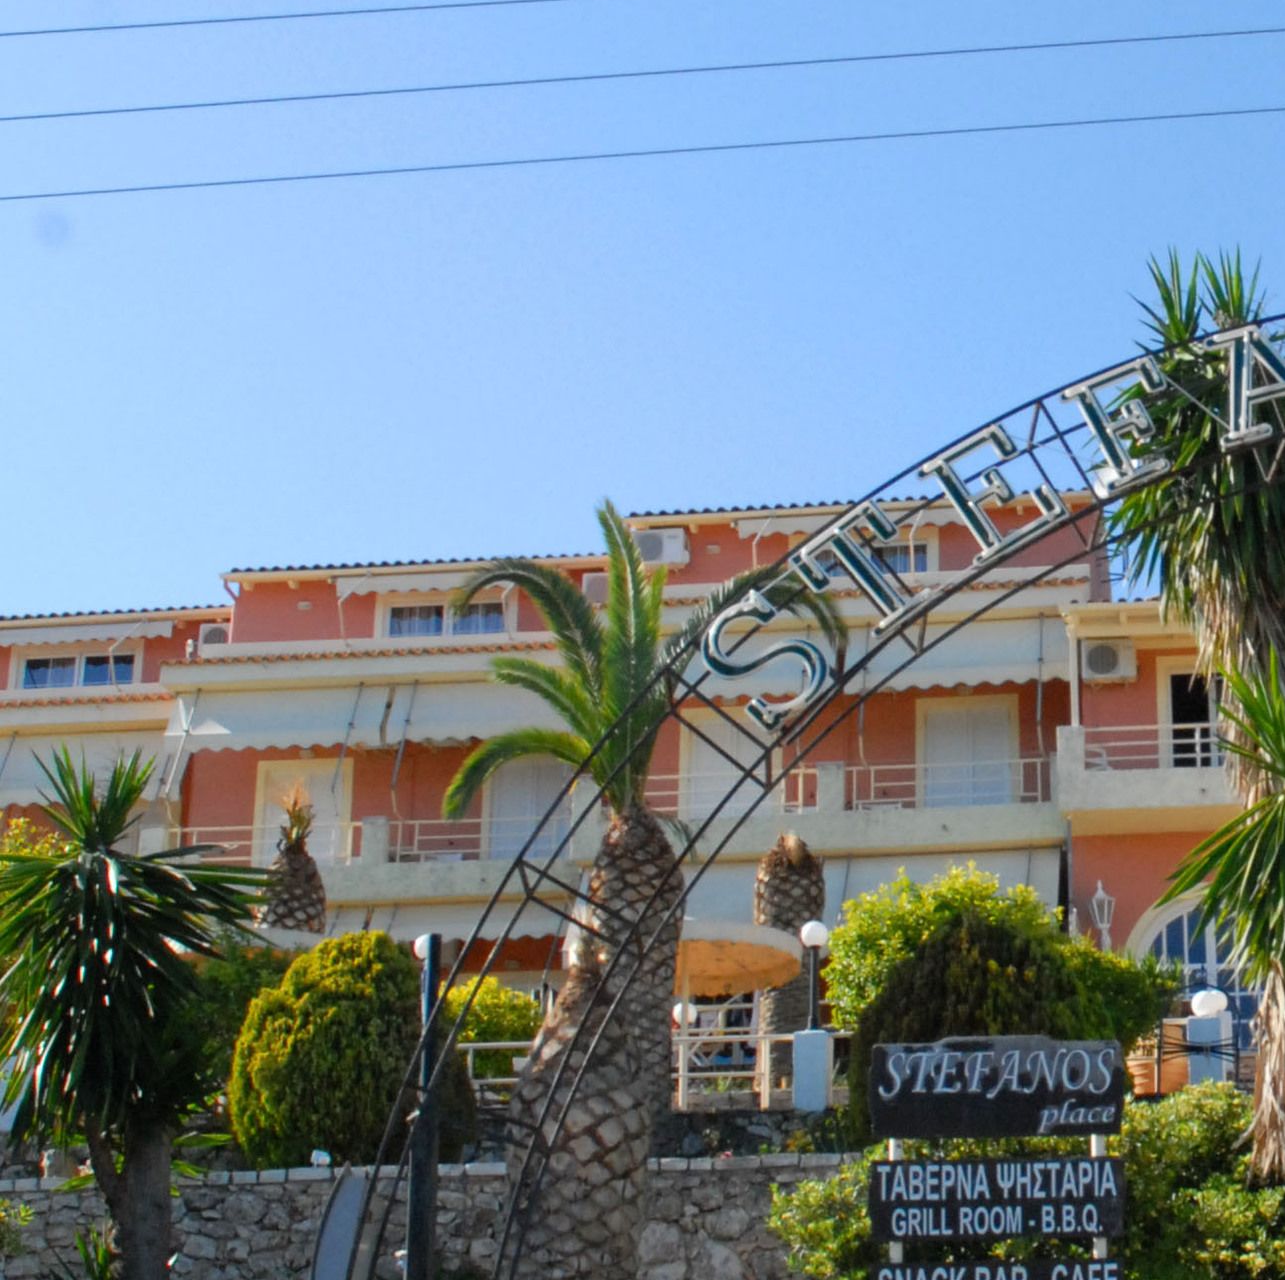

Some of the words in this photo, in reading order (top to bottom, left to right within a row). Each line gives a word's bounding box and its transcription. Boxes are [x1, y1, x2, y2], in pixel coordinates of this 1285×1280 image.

[878, 1048, 1115, 1099] STEFANOS
[1038, 1098, 1116, 1134] place
[877, 1163, 990, 1201] ΤΑΒΕΡΝΑ
[996, 1161, 1117, 1199] ΨΗΣΤΑΡΙΑ
[891, 1207, 953, 1236] GRILL
[959, 1205, 1023, 1234] ROOM
[1041, 1204, 1103, 1233] B.B.Q.
